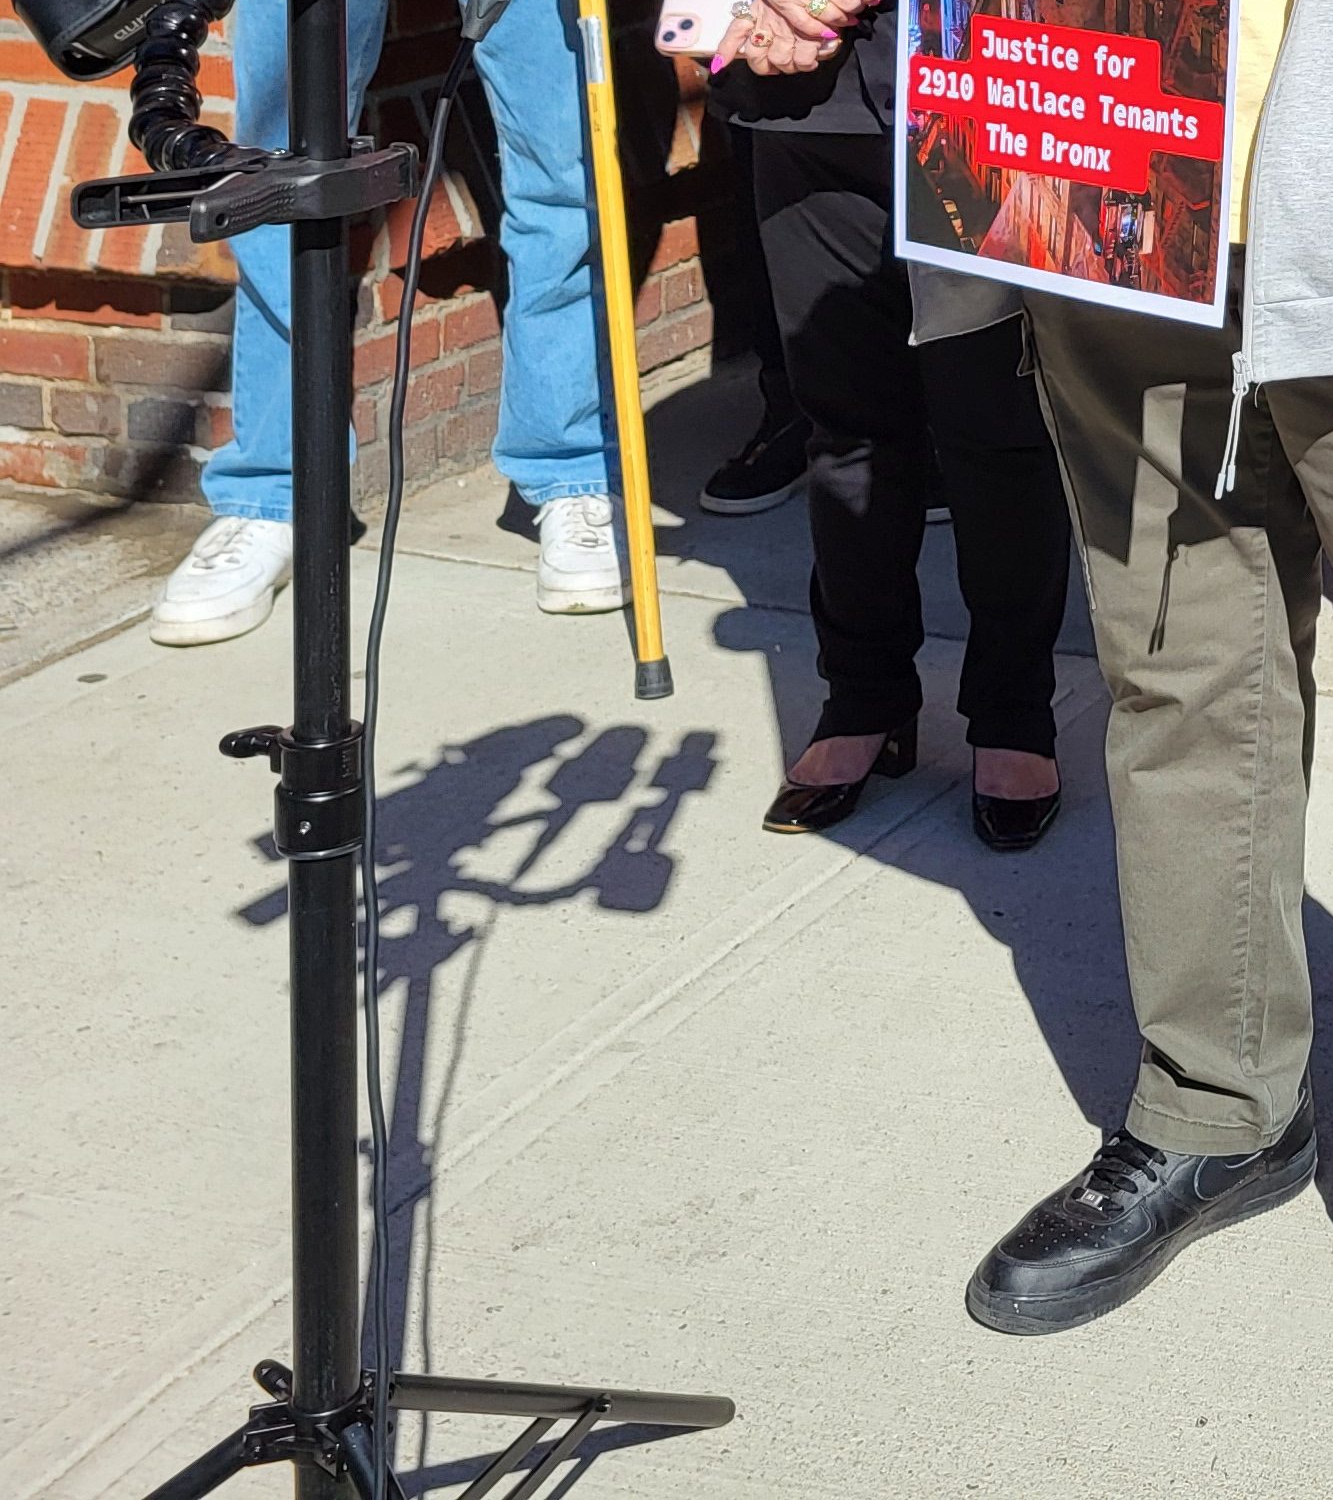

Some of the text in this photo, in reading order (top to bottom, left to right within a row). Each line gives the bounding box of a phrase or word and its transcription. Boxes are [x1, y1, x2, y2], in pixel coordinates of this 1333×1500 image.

[981, 30, 1136, 80] Justice for
[917, 68, 1199, 140] 2910 Wallace Tenants
[986, 124, 1112, 172] The Bronx
